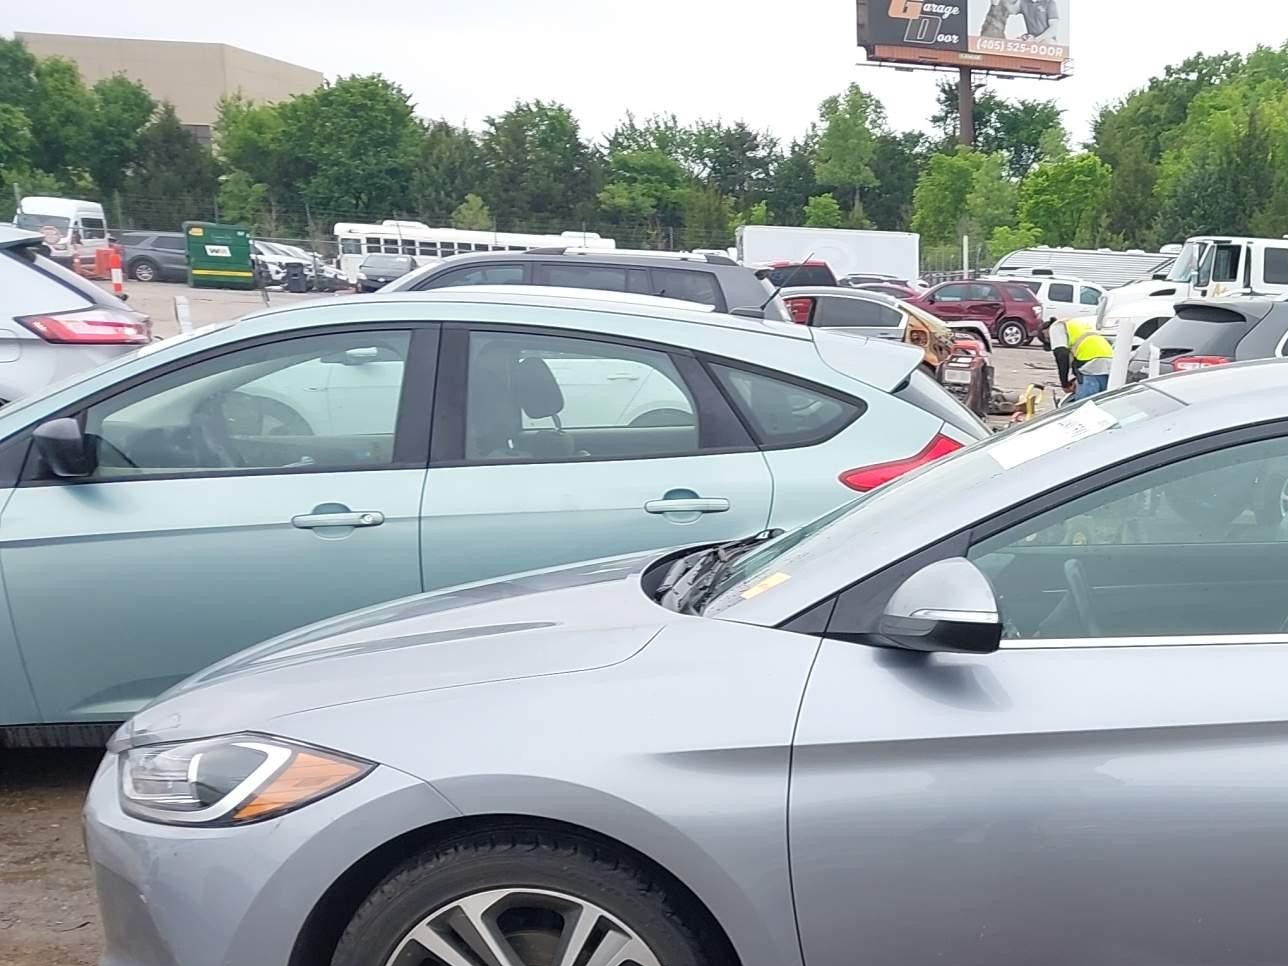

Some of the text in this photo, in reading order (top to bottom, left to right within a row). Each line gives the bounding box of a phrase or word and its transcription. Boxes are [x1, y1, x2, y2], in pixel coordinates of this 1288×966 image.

[904, 15, 959, 44] Door
[976, 39, 1064, 57] (405) 525-DOOR
